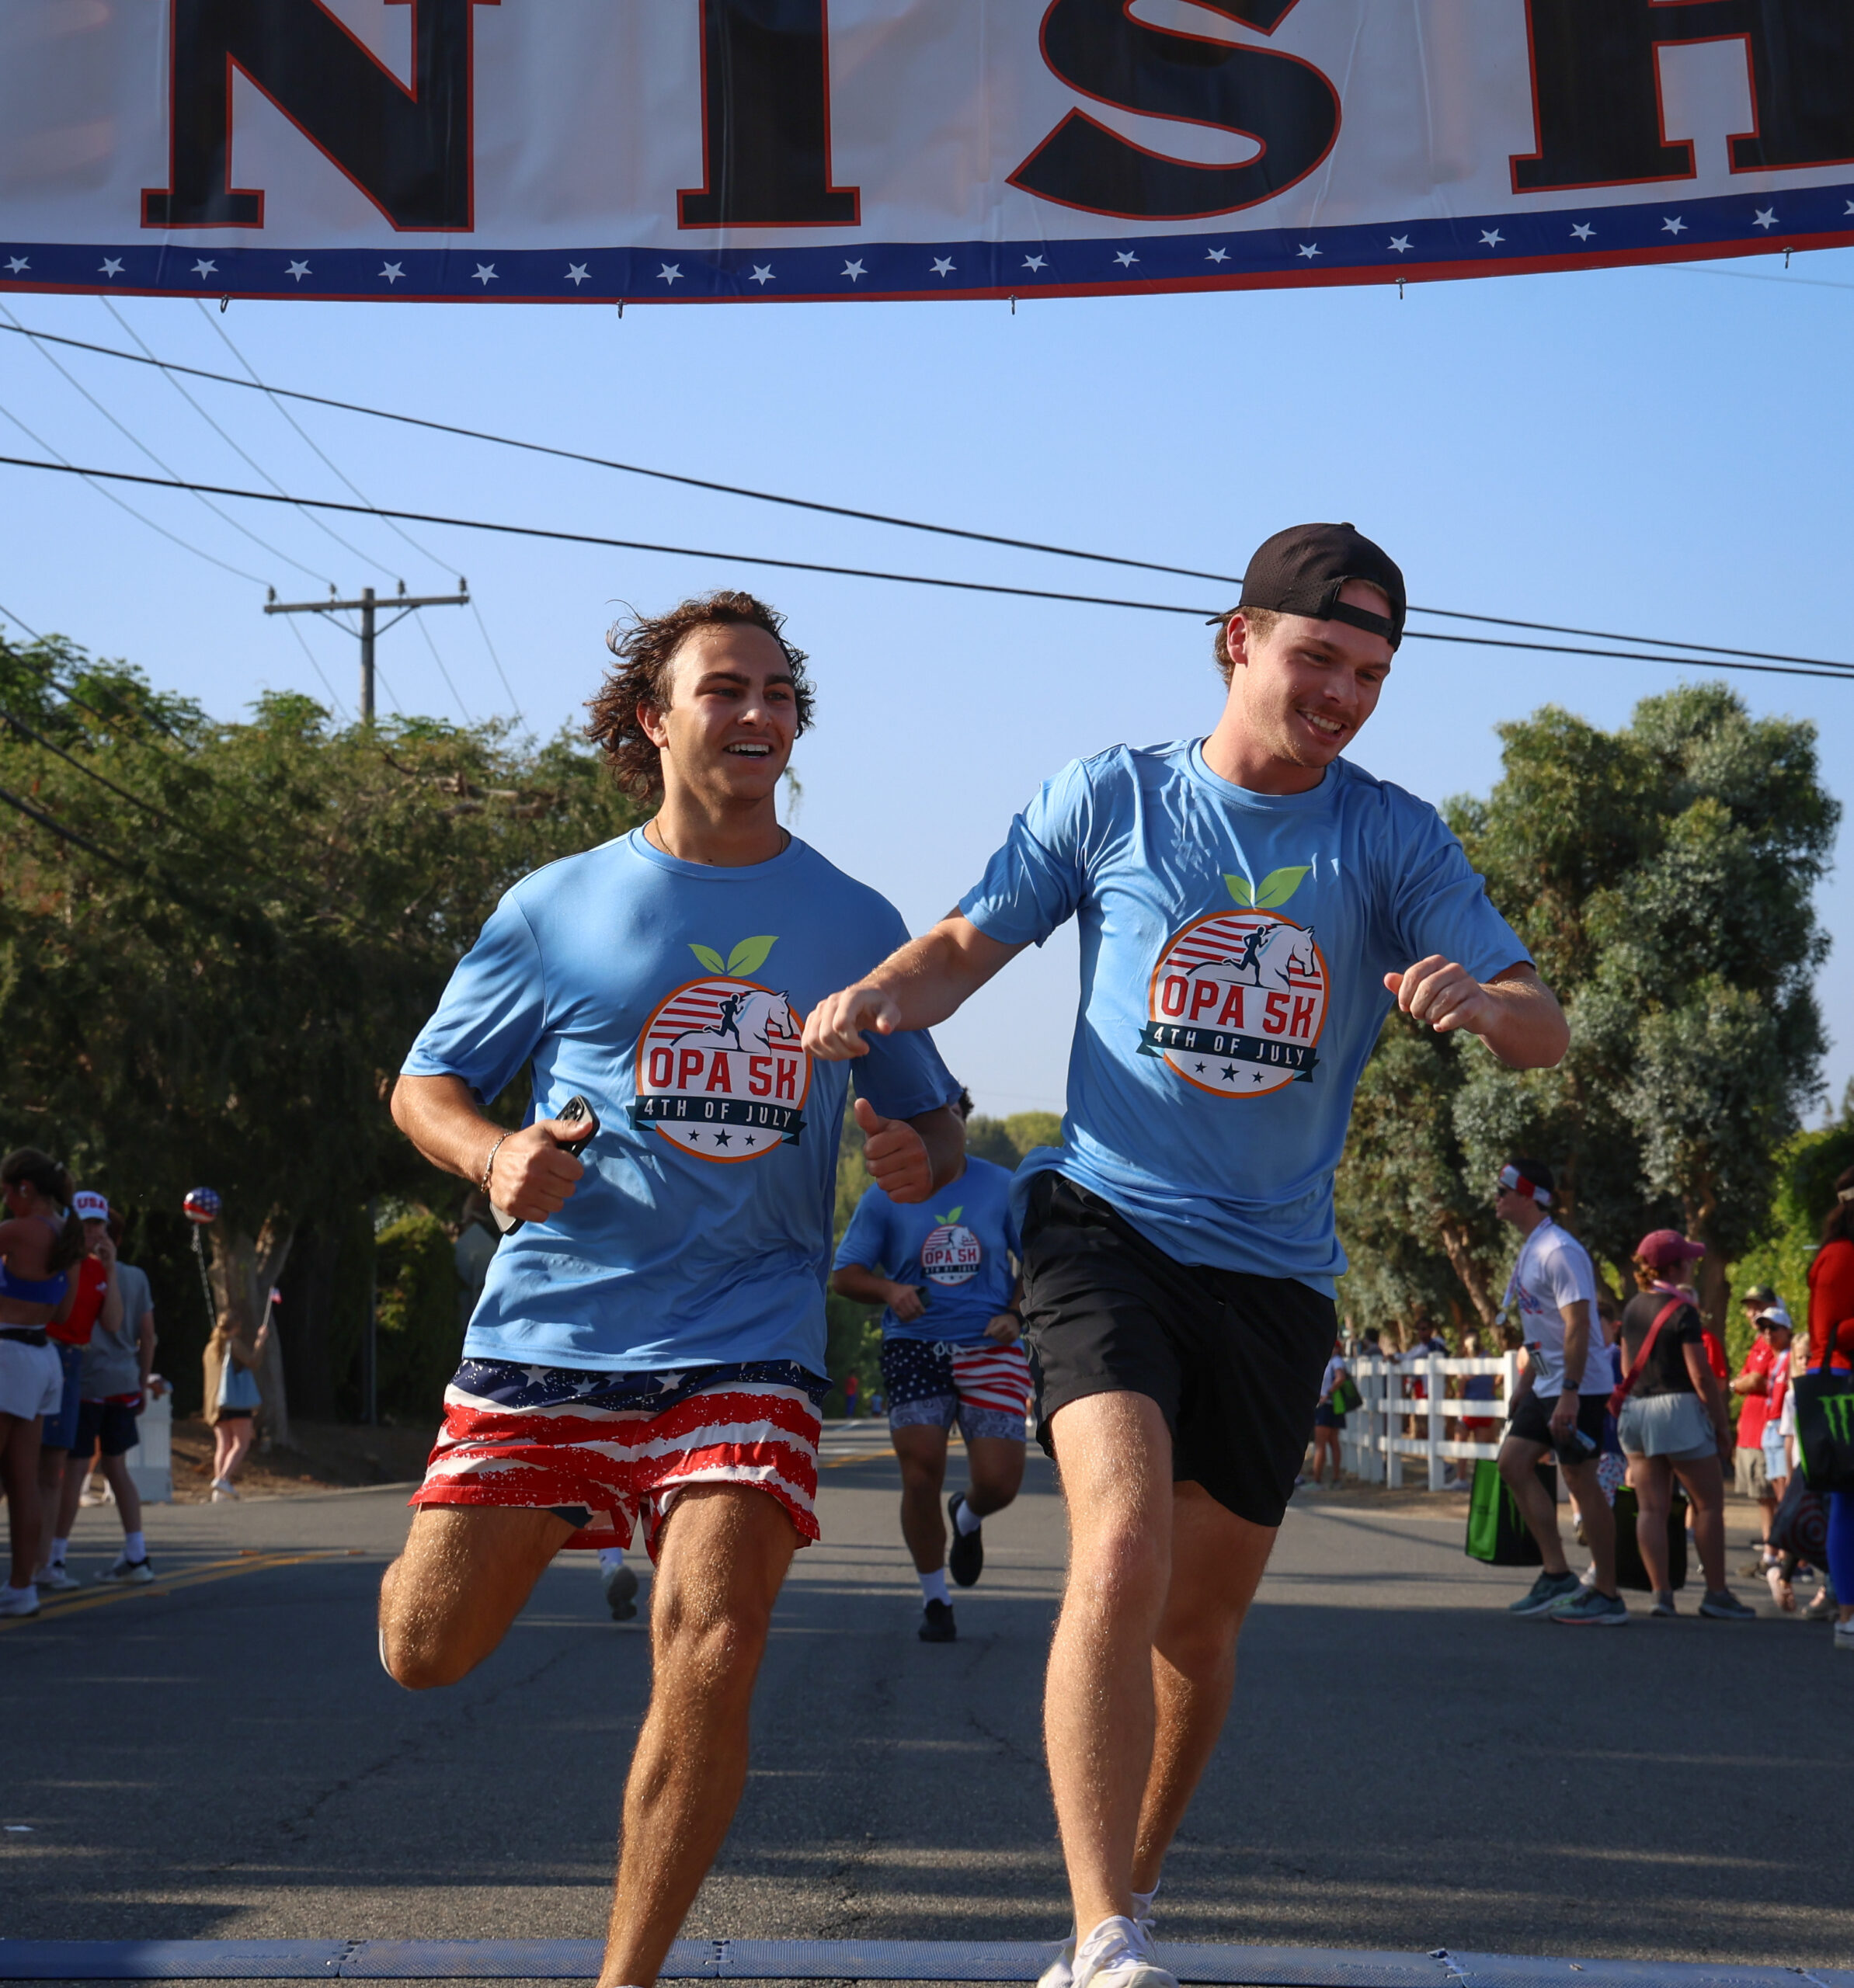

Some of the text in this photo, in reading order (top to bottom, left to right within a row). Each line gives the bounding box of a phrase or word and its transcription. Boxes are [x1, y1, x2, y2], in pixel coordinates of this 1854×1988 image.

[1161, 975, 1316, 1038] OPA 5K
[1153, 1026, 1304, 1065] 4TH OF JULY
[648, 1047, 798, 1100] OPA 5K
[644, 1098, 791, 1128] 4TH OF JULY
[925, 1249, 954, 1264] OPA
